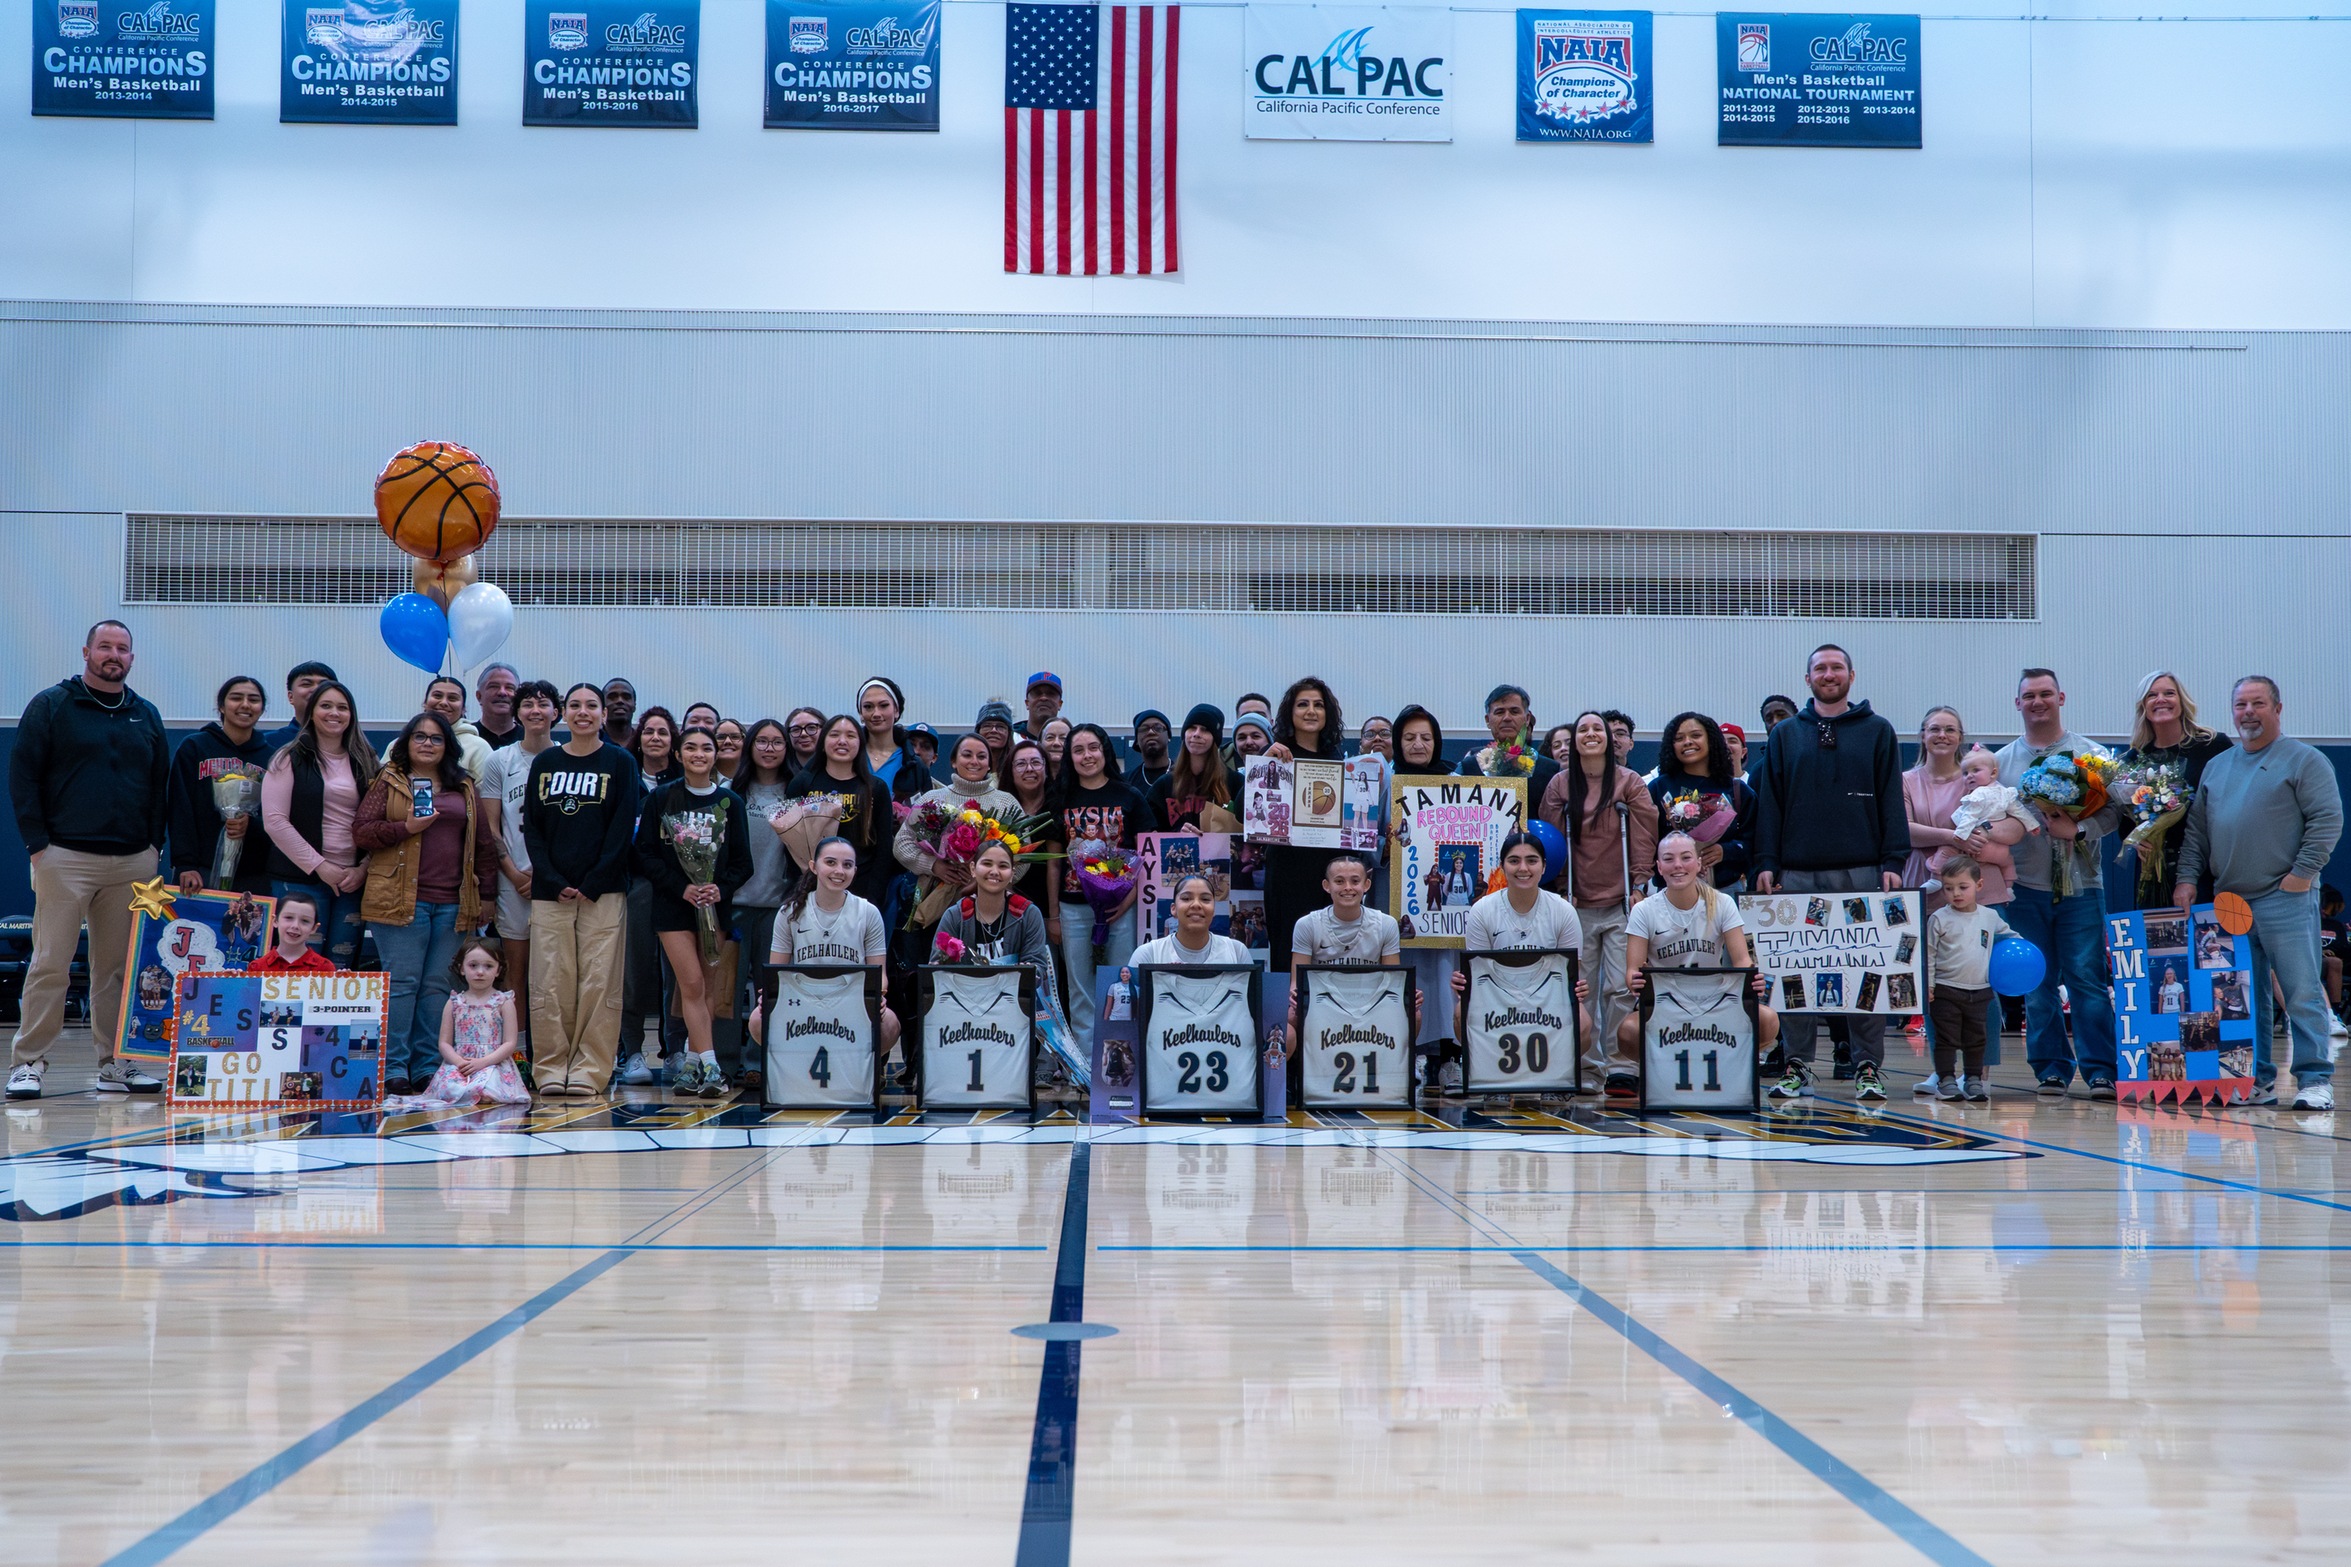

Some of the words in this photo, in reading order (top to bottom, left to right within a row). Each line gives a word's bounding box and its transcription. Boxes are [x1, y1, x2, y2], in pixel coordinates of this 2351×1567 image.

[60, 7, 95, 19] NAIA
[118, 12, 158, 33] CAL
[162, 13, 199, 33] PAC
[307, 14, 343, 26] NAIA
[364, 20, 403, 40] CAL
[407, 20, 444, 40] PAC
[551, 19, 585, 31] NAIA
[606, 24, 643, 43] CAL
[648, 25, 685, 45] PAC
[791, 22, 826, 34] NAIA
[1741, 26, 1766, 34] NAIA
[846, 28, 884, 47] CAL
[889, 29, 925, 48] PAC
[74, 46, 177, 55] CONFERENCE
[320, 53, 422, 62] CONFERENCE
[1540, 38, 1628, 74] NAIA
[1810, 37, 1856, 61] CAL
[1862, 38, 1906, 62] PAC
[563, 58, 663, 66] CONFERENCE
[803, 61, 904, 69] CONFERENCE
[109, 78, 200, 91] Basketball
[1255, 54, 1345, 95] CAL
[1358, 57, 1443, 96] PAC
[1551, 77, 1615, 87] Champions
[1803, 74, 1884, 86] Basketball
[356, 84, 444, 96] Basketball
[597, 89, 684, 101] Basketball
[838, 92, 926, 104] Basketball
[1547, 88, 1559, 98] of
[1562, 88, 1621, 98] Character
[1723, 88, 1801, 99] NATIONAL
[1806, 89, 1914, 101] TOURNAMENT
[342, 98, 397, 106] 2014-2015
[583, 102, 638, 110] 2015-2016
[1257, 100, 1318, 113] California
[1322, 101, 1363, 114] Pacific
[1366, 102, 1440, 115] Conference
[1798, 106, 1850, 114] 2012-2013
[1723, 114, 1775, 122] 2014-2015
[1797, 116, 1850, 124] 2015-2016
[1539, 128, 1631, 138] WWW.NAIA.ORG
[539, 771, 611, 801] COURT
[1395, 784, 1522, 819] TAMANA
[1417, 805, 1492, 828] REBOUND
[1429, 823, 1488, 841] QUEEN!
[1407, 845, 1420, 915] 2026
[263, 977, 382, 1000] SENIOR
[2110, 918, 2146, 1079] EMILY
[313, 1005, 371, 1013] 3-POINTER
[183, 1010, 211, 1035] #4
[1484, 1007, 1562, 1032] Keelhaulers
[786, 1016, 856, 1044] Keelhaulers
[939, 1022, 1015, 1048] Keelhaulers
[1162, 1024, 1242, 1050] Keelhaulers
[1320, 1024, 1396, 1050] Keelhaulers
[1659, 1022, 1737, 1048] Keelhaulers
[1498, 1032, 1548, 1074] 30
[222, 1052, 261, 1075] GO
[808, 1046, 831, 1088] 4
[967, 1049, 985, 1092] 1
[1178, 1050, 1230, 1094] 23
[1333, 1051, 1380, 1094] 21
[1674, 1049, 1722, 1092] 11
[207, 1078, 270, 1100] TITI
